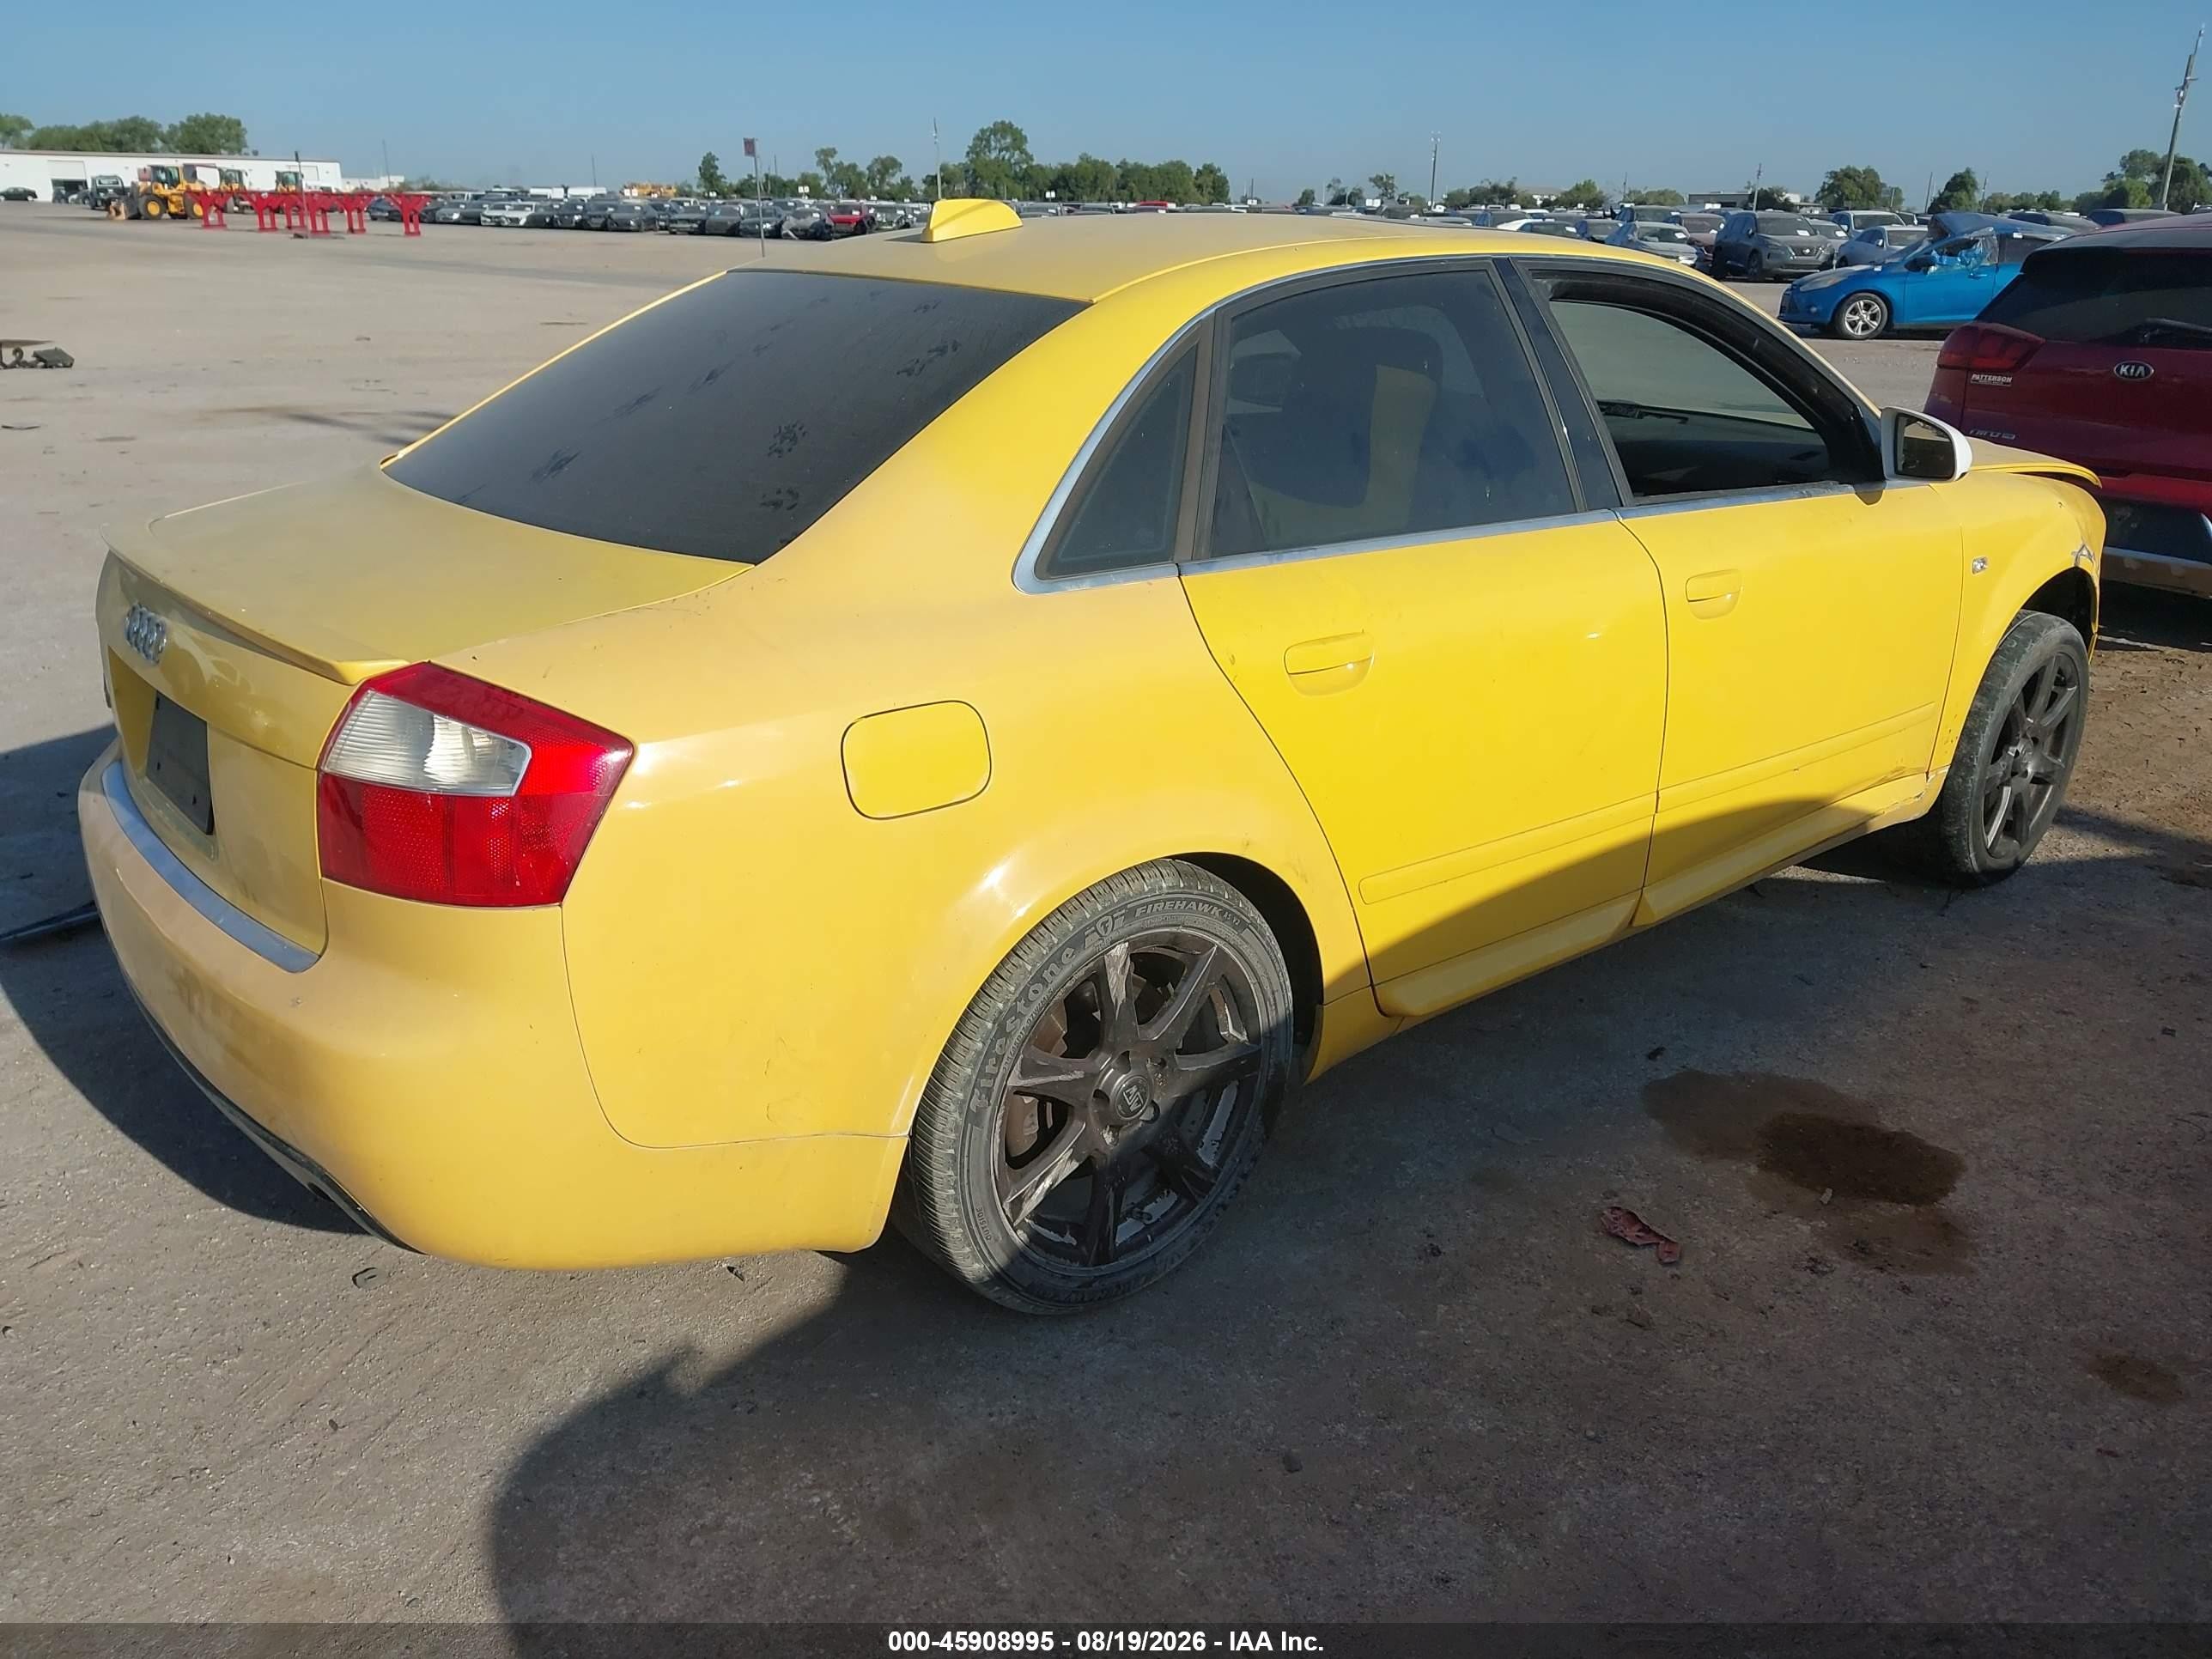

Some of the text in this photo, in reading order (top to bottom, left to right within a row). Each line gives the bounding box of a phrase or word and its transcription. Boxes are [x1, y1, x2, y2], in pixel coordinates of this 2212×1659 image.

[1971, 374, 2014, 383] PATTERSON
[2119, 364, 2145, 377] KIA
[1134, 899, 1223, 918] FIREHAWK
[969, 947, 1076, 1113] Firestone
[975, 1206, 992, 1241] OUTSIDE
